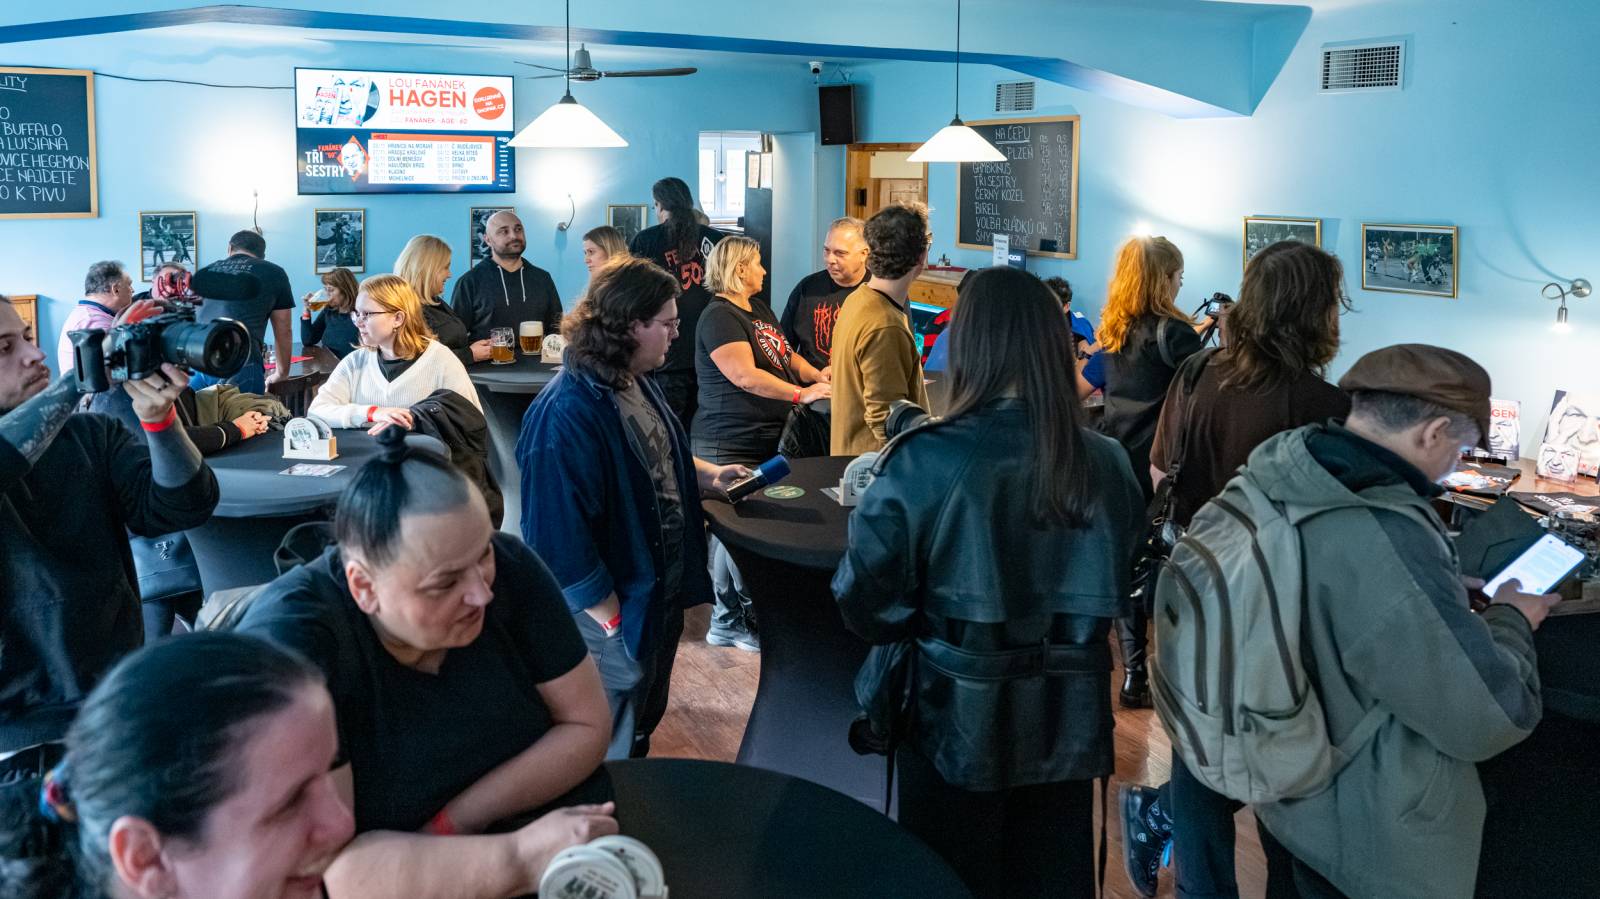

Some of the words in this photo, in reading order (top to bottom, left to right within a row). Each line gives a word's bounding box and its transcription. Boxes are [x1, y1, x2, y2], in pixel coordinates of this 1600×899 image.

[388, 78, 413, 88] LOU
[415, 78, 466, 90] FANÁNEK
[389, 88, 466, 108] HAGEN
[2, 121, 63, 137] BUFFALO
[995, 127, 1006, 140] NA
[1007, 124, 1031, 141] ČEPU
[7, 136, 69, 151] LUISIANA
[305, 148, 324, 164] TŘI
[1007, 144, 1034, 160] PLZEŇ
[0, 153, 31, 168] VICE
[31, 153, 90, 171] HEGEMON
[17, 168, 77, 185] NAJDETE
[305, 164, 345, 178] SESTRY
[987, 175, 1017, 189] SESTRY
[15, 185, 26, 201] K
[28, 185, 66, 202] PIVU
[974, 186, 999, 201] ČERNÝ
[1001, 188, 1025, 202] KOZEL
[974, 201, 1001, 215] BIRELL
[1002, 215, 1034, 235] SLÁDKŮ
[975, 227, 995, 242] ŠNY
